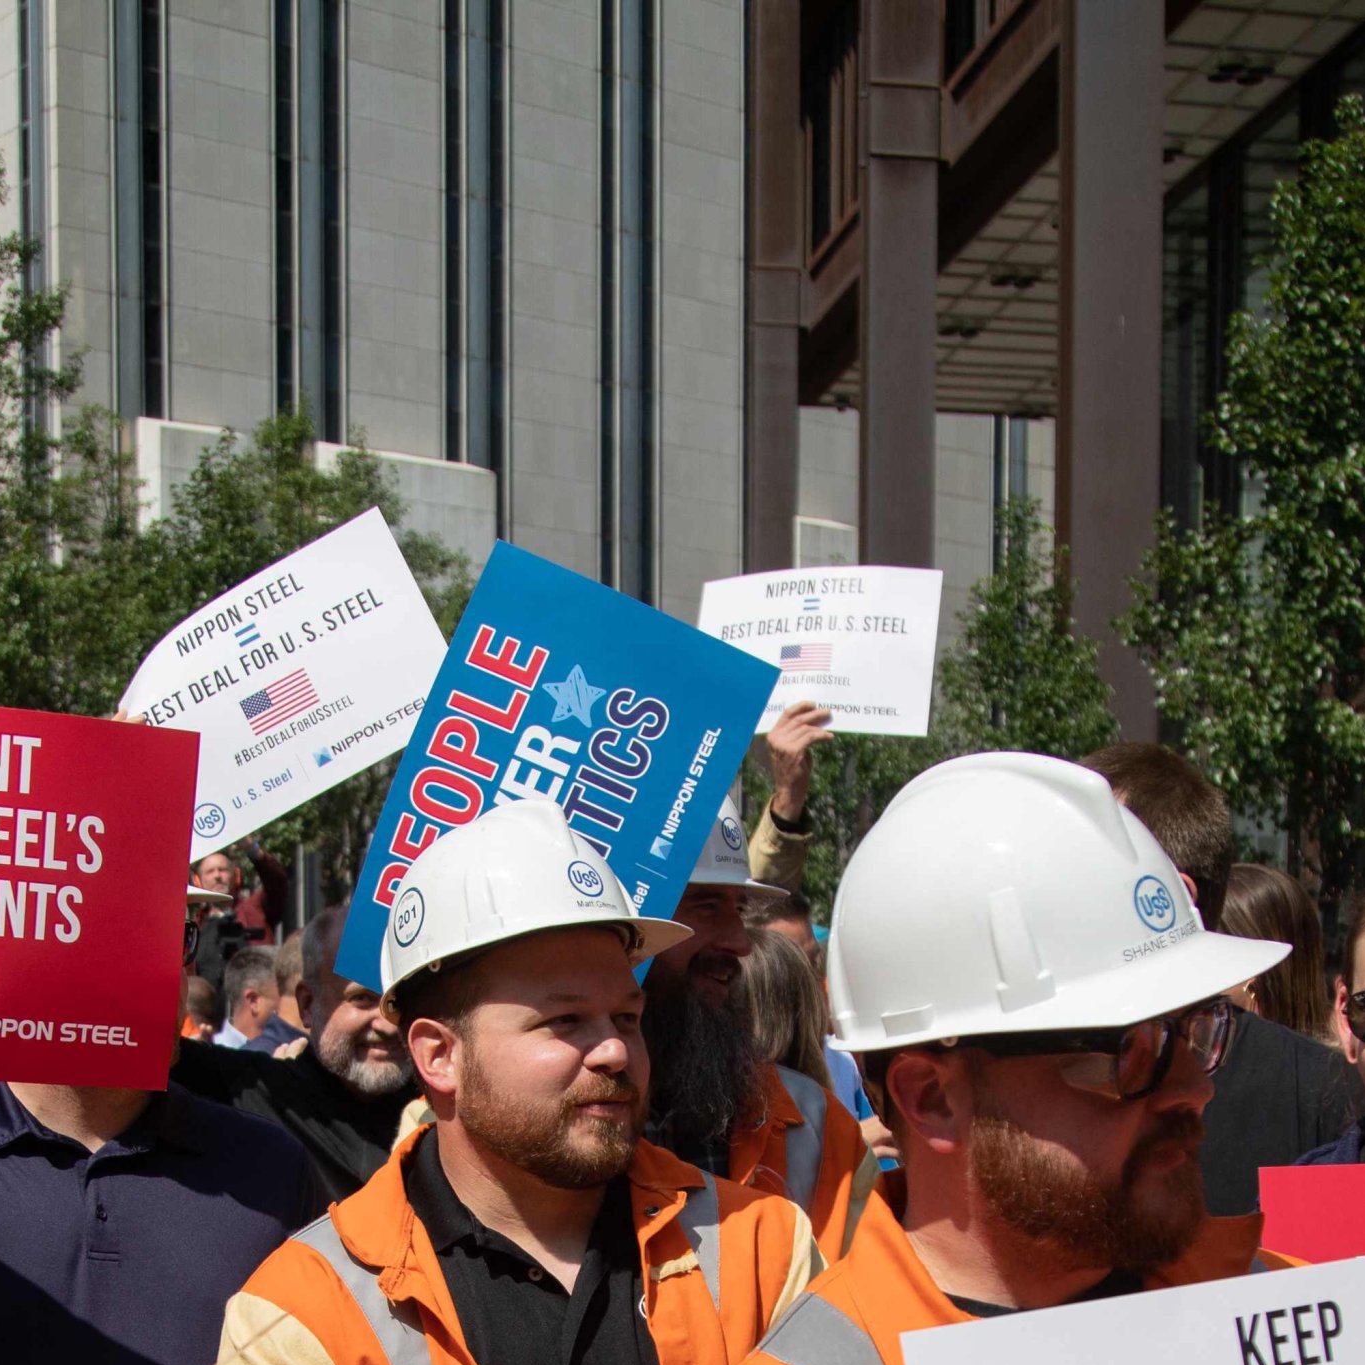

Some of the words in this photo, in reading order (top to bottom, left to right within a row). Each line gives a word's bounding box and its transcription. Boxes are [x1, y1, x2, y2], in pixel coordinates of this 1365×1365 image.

[766, 579, 816, 598] NIPPON
[821, 577, 865, 594] STEEL
[175, 605, 243, 657] NIPPON
[243, 573, 305, 616] STEEL
[721, 622, 754, 640] BEST
[757, 618, 791, 636] DEAL
[796, 615, 824, 632] FOR
[828, 615, 842, 631] U.
[846, 616, 859, 631] S.
[863, 616, 909, 634] STEEL
[187, 665, 240, 704] DEAL
[239, 642, 279, 676] FOR
[279, 631, 302, 654] U.
[302, 621, 324, 643] S.
[322, 588, 384, 632] STEEL
[863, 705, 900, 716] STEEL
[232, 796, 247, 810] U.
[248, 788, 263, 801] S.
[262, 768, 293, 793] Steel
[331, 722, 385, 756] NIPPON
[385, 696, 429, 727] STEEL
[660, 777, 694, 840] NIPPON
[689, 727, 722, 778] STEEL
[398, 904, 417, 931] 201
[1123, 935, 1168, 962] SHANE
[59, 1022, 138, 1047] STEEL
